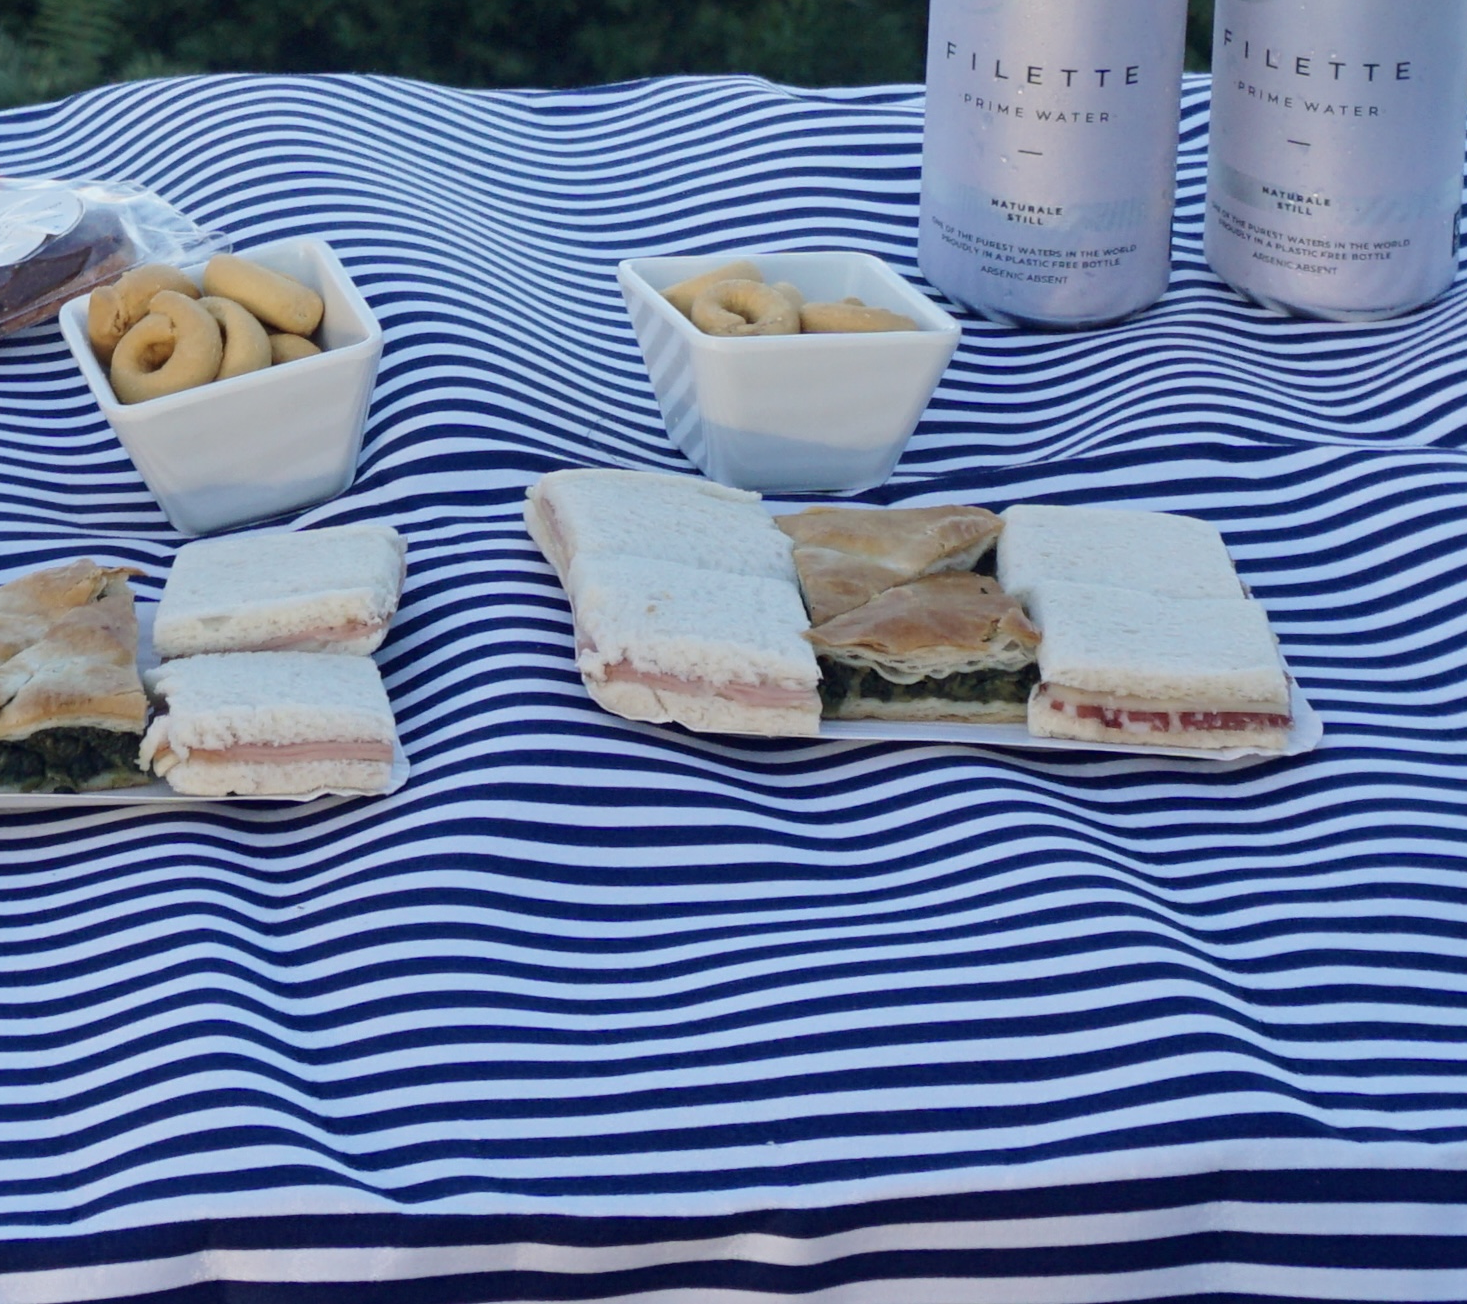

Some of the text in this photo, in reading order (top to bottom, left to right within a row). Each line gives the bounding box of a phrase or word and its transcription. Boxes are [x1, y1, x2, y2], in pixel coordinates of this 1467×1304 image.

[946, 41, 1139, 88] FILETTE
[1223, 28, 1411, 82] FILETTE
[963, 93, 1110, 124] PRIME WATER
[1238, 80, 1379, 117] PRIME WATER
[991, 198, 1064, 216] NATURALE
[1262, 186, 1332, 207] NATURALE
[1007, 212, 1044, 226] STILL
[1277, 202, 1313, 216] STILL
[957, 230, 974, 242] THE
[975, 237, 1015, 252] PUREST
[1017, 246, 1062, 258] WATERS
[1065, 250, 1077, 258] IN
[1080, 250, 1099, 258] THE
[1103, 244, 1137, 257] WORLD
[1231, 215, 1246, 228] THE
[1248, 223, 1284, 240] PUREST
[1287, 235, 1331, 249] WATERS
[1334, 242, 1346, 250] IN
[1349, 242, 1370, 250] THE
[1373, 238, 1411, 250] WORLD
[982, 250, 993, 259] IN
[995, 253, 1003, 261] A
[1005, 256, 1049, 268] PLASTIC
[1052, 261, 1078, 269] FREE
[1082, 258, 1121, 269] BOTTLE
[1254, 236, 1263, 245] IN
[1266, 240, 1273, 248] A
[1275, 243, 1318, 258] PLASTIC
[1321, 251, 1348, 260] FREE
[1351, 251, 1392, 261] BOTTLE
[980, 265, 1069, 285] ARSENIC ABSENT
[1252, 251, 1338, 275] ARSENIC ABSENT
